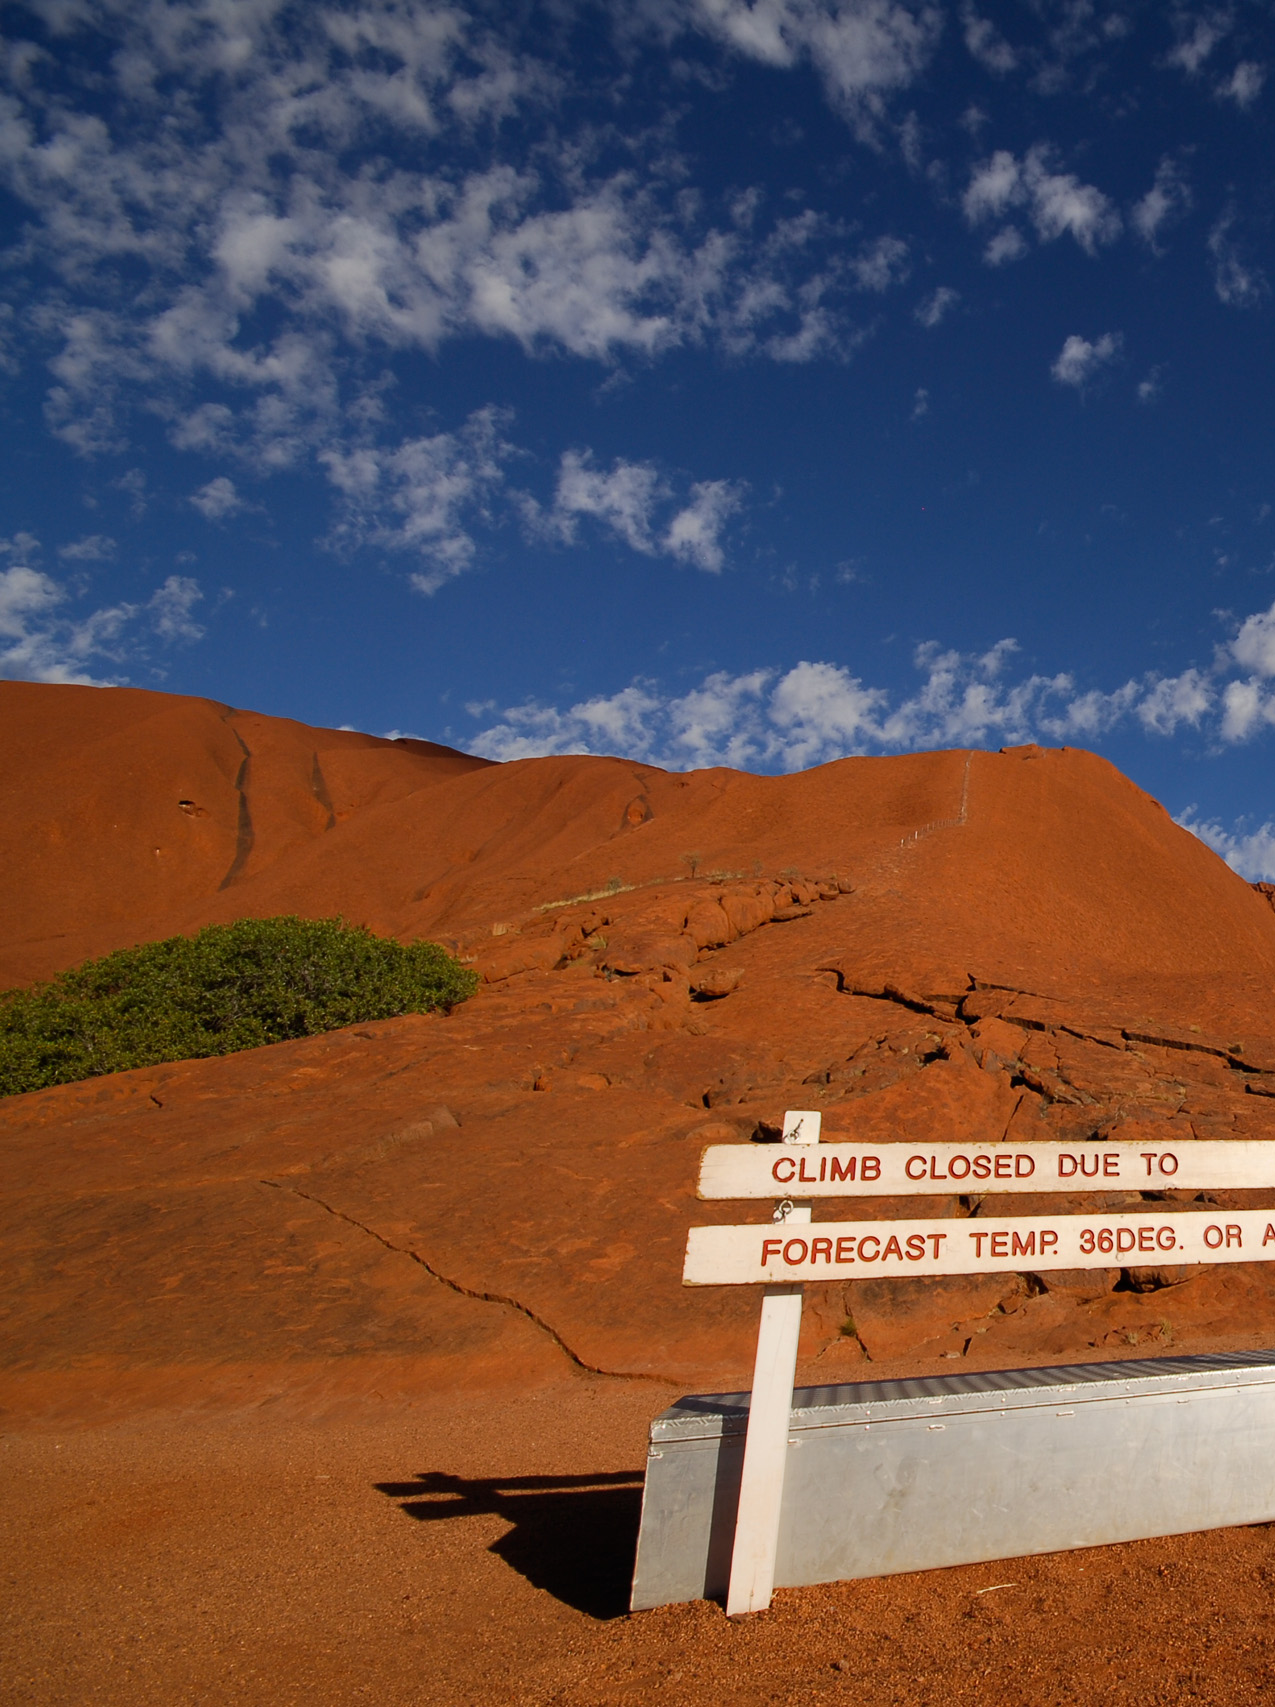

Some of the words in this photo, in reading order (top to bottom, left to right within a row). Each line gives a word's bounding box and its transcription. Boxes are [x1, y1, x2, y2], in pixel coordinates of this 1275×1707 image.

[771, 1155, 882, 1184] CLIMB
[904, 1154, 1036, 1181] CLOSED
[1057, 1153, 1121, 1178] DUE
[1139, 1152, 1179, 1177] TO
[760, 1233, 948, 1267] FORECAST
[968, 1229, 1059, 1259] TEMP.
[1079, 1226, 1184, 1255] 36DEG.
[1203, 1224, 1243, 1250] OR
